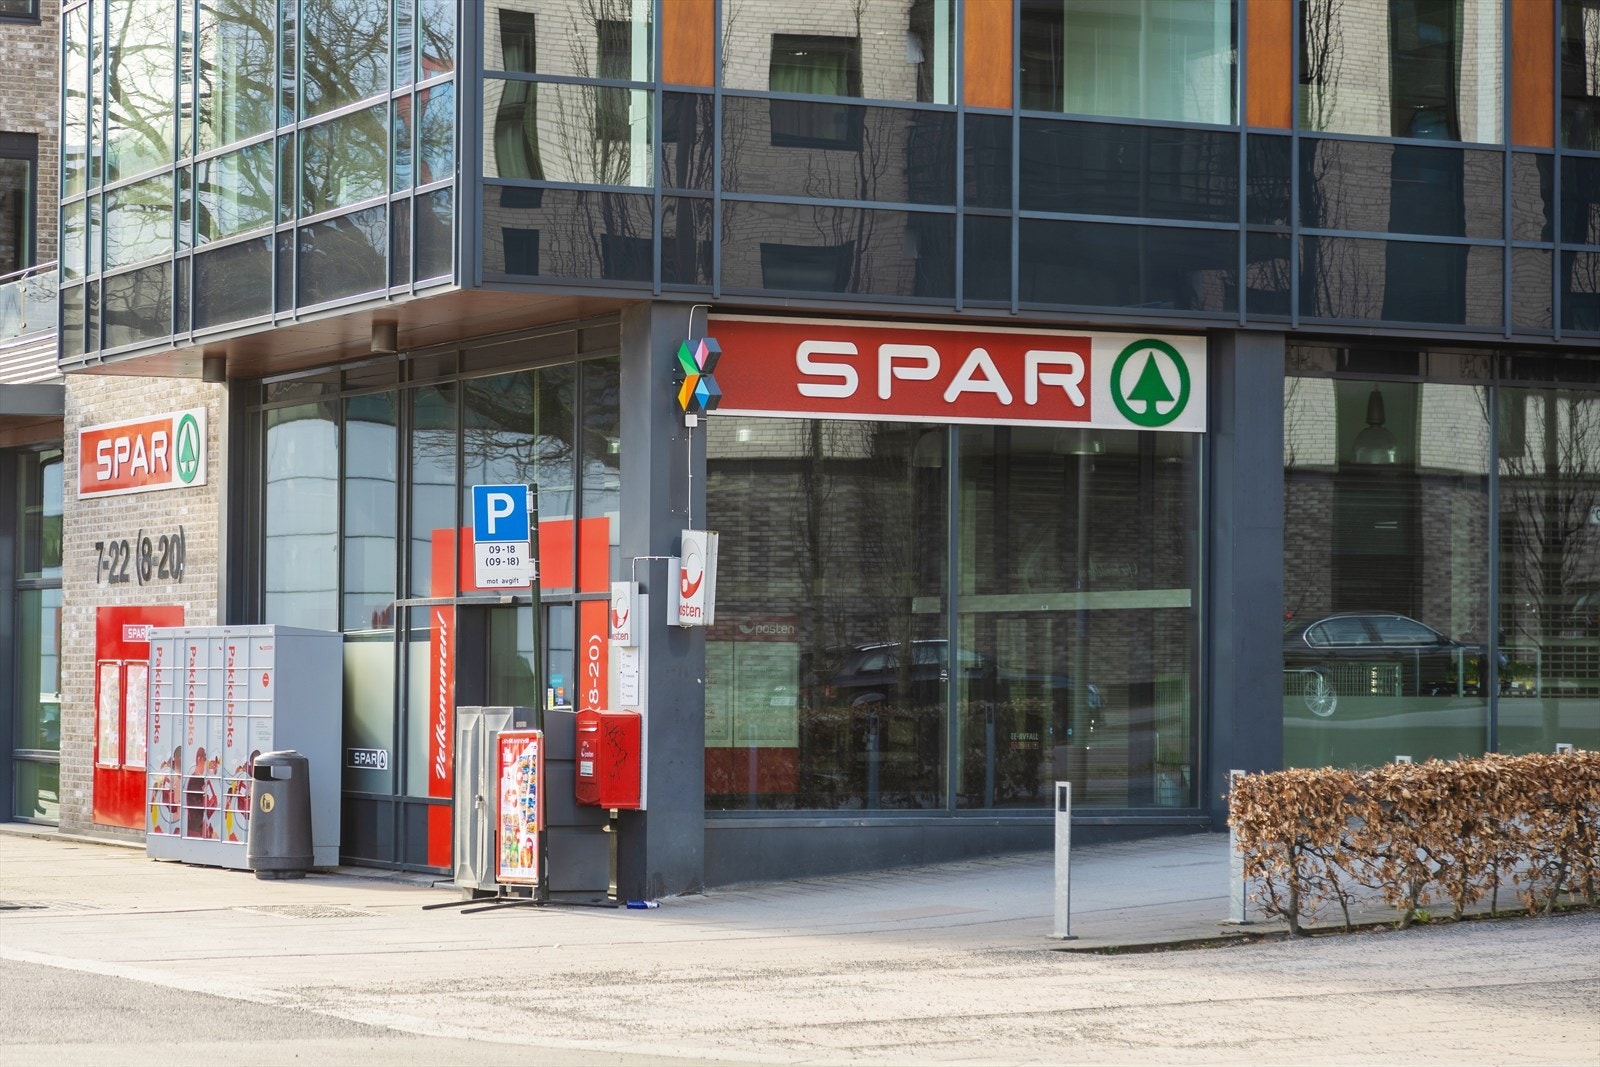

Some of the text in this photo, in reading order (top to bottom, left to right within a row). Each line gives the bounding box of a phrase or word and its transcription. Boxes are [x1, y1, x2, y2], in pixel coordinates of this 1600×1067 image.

[796, 340, 1086, 407] SPAR
[96, 430, 169, 481] SPAR
[487, 493, 515, 534] P
[95, 525, 186, 586] 7-22 (8-20)
[485, 557, 520, 567] (09-18)
[489, 545, 516, 554] 09-18
[501, 577, 520, 585] avgift
[127, 627, 146, 640] SPAR
[755, 623, 795, 635] posten
[153, 646, 163, 744] Pakkeboks
[188, 646, 197, 746] Pakkeboks
[226, 646, 236, 748] Pakkeboks
[435, 611, 448, 779] Velkommen!
[354, 752, 378, 765] SPAR
